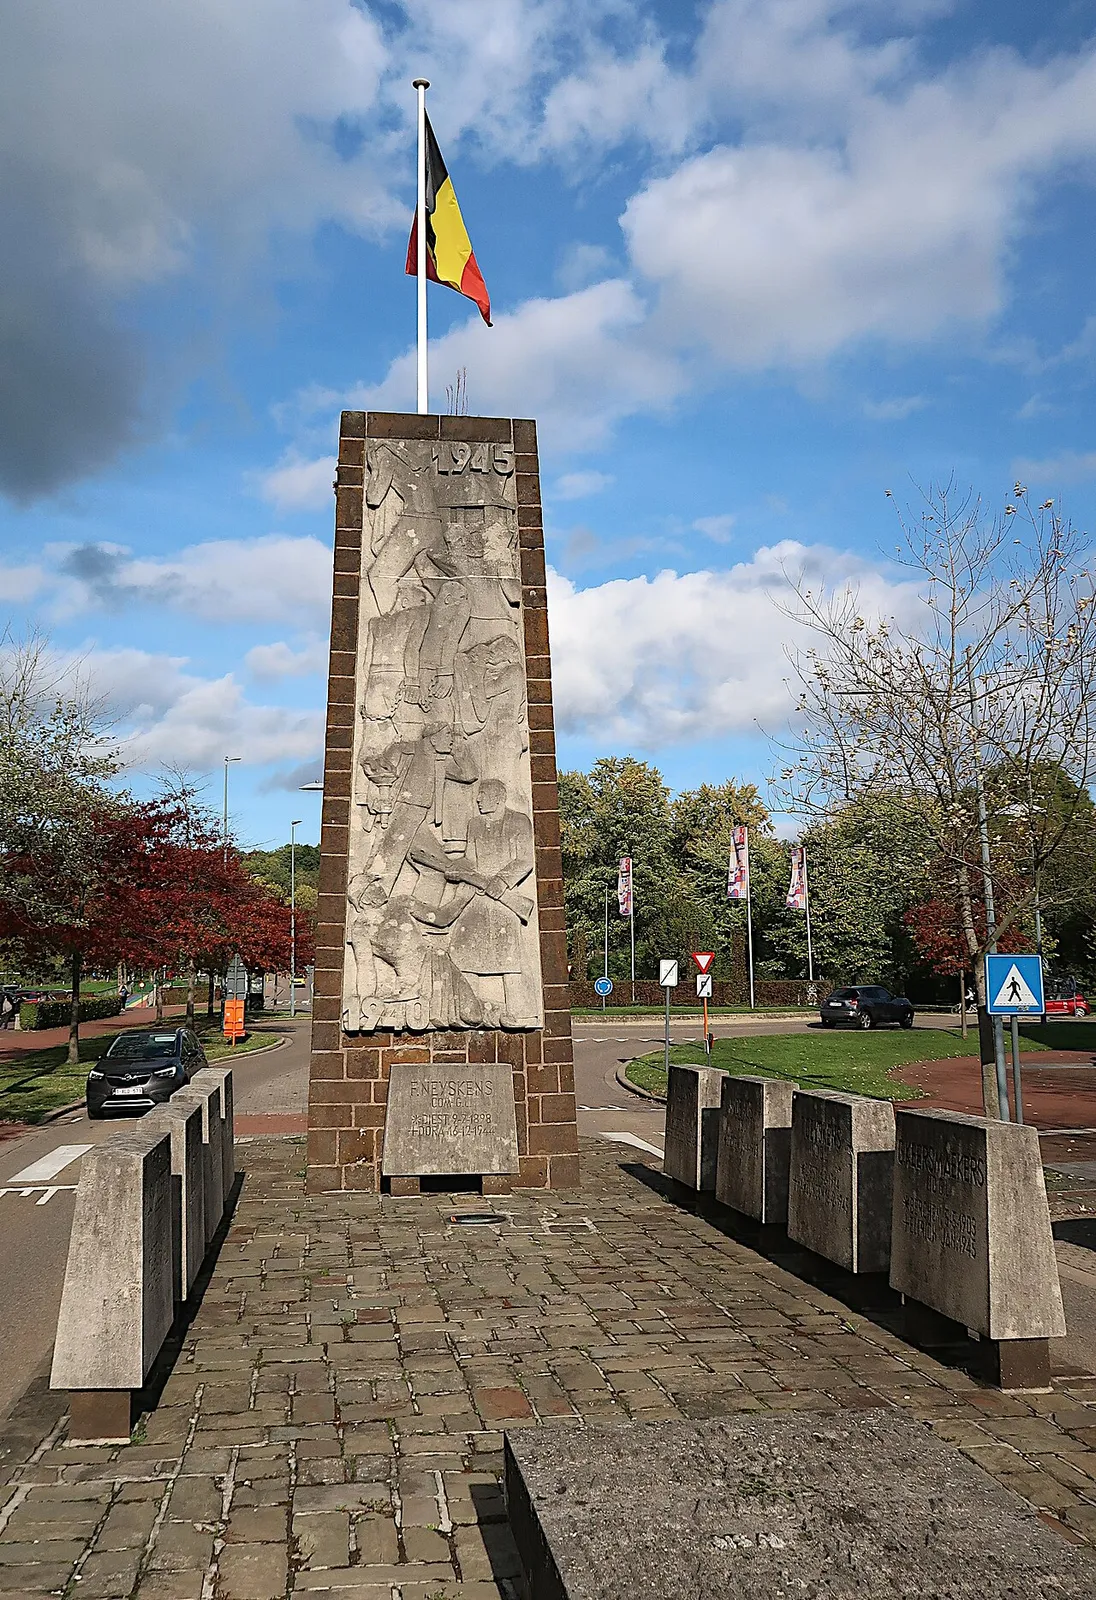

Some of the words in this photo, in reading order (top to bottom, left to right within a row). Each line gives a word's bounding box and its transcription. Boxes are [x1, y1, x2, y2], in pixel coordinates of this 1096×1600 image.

[431, 442, 514, 479] 1945
[341, 996, 430, 1032] 1940
[410, 1080, 493, 1096] F.NEYSKENS
